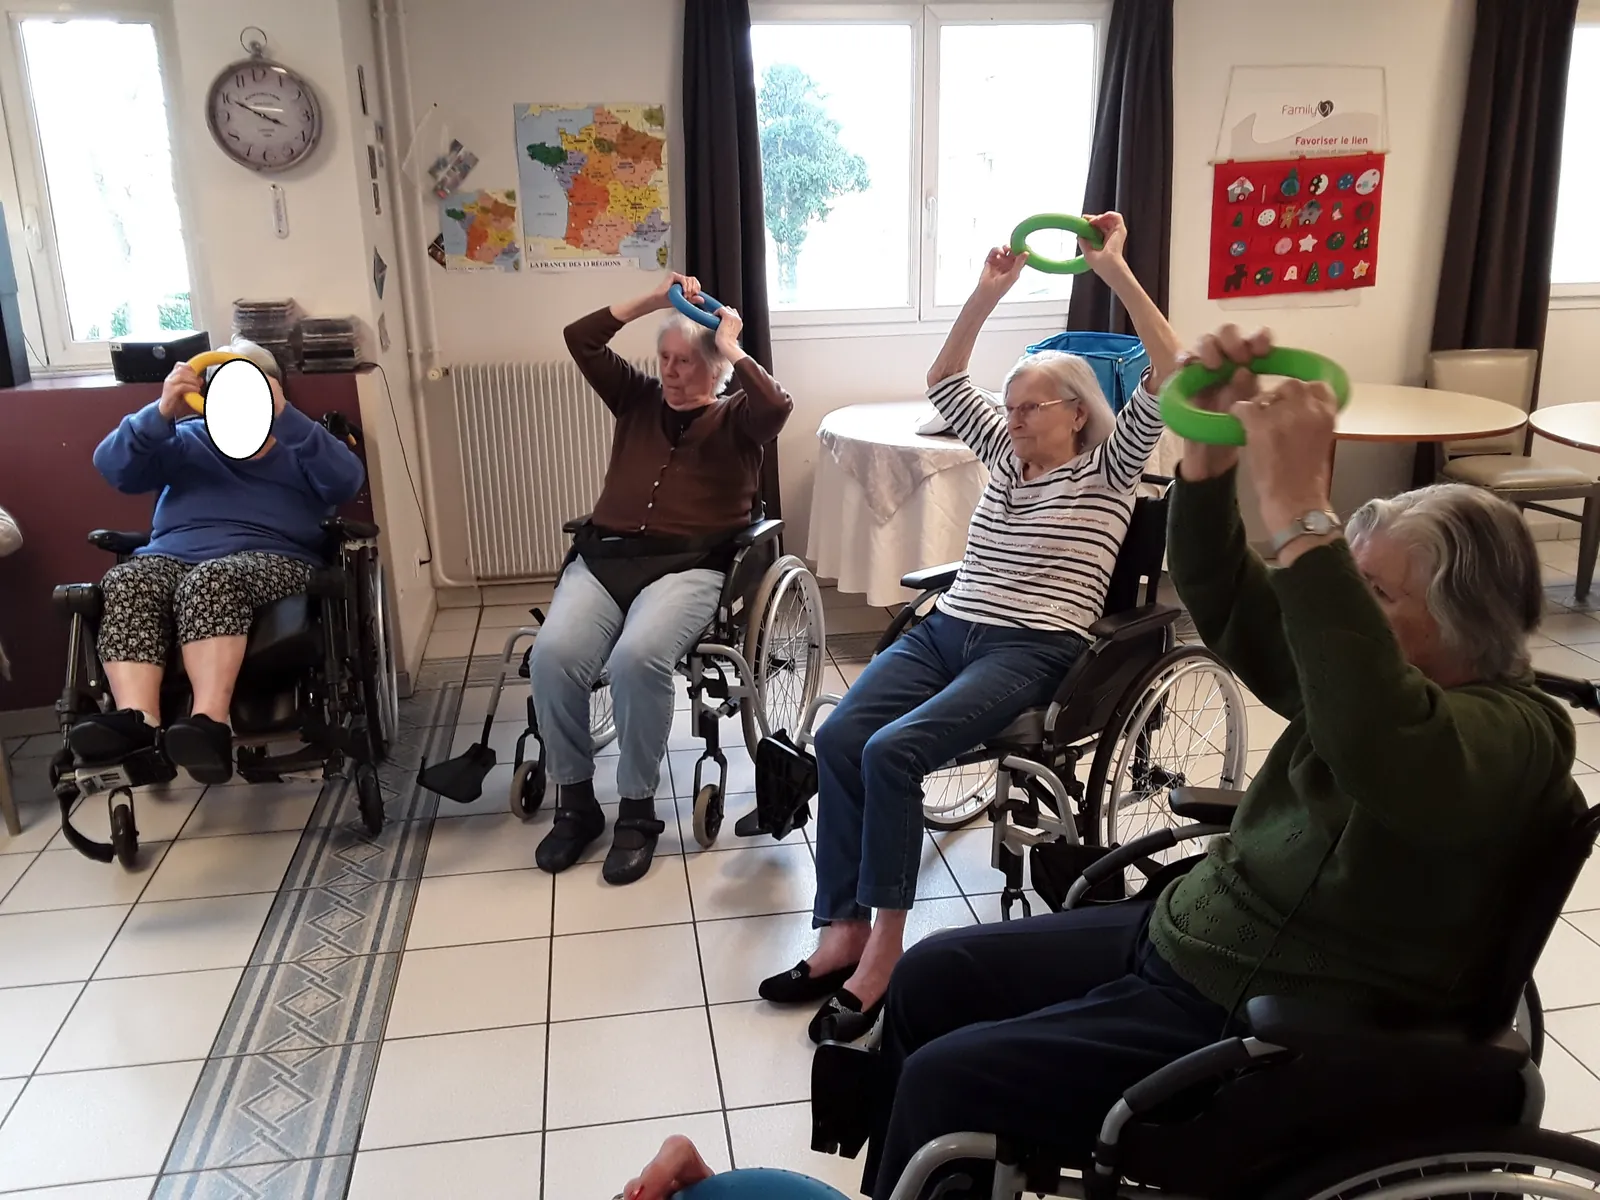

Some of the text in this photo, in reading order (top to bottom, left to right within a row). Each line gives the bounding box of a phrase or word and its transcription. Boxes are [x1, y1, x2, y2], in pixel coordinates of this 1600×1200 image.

[1295, 135, 1368, 146] Favoriser le lien
[539, 261, 566, 269] FRANCE
[591, 260, 621, 268] RÉGIONS
